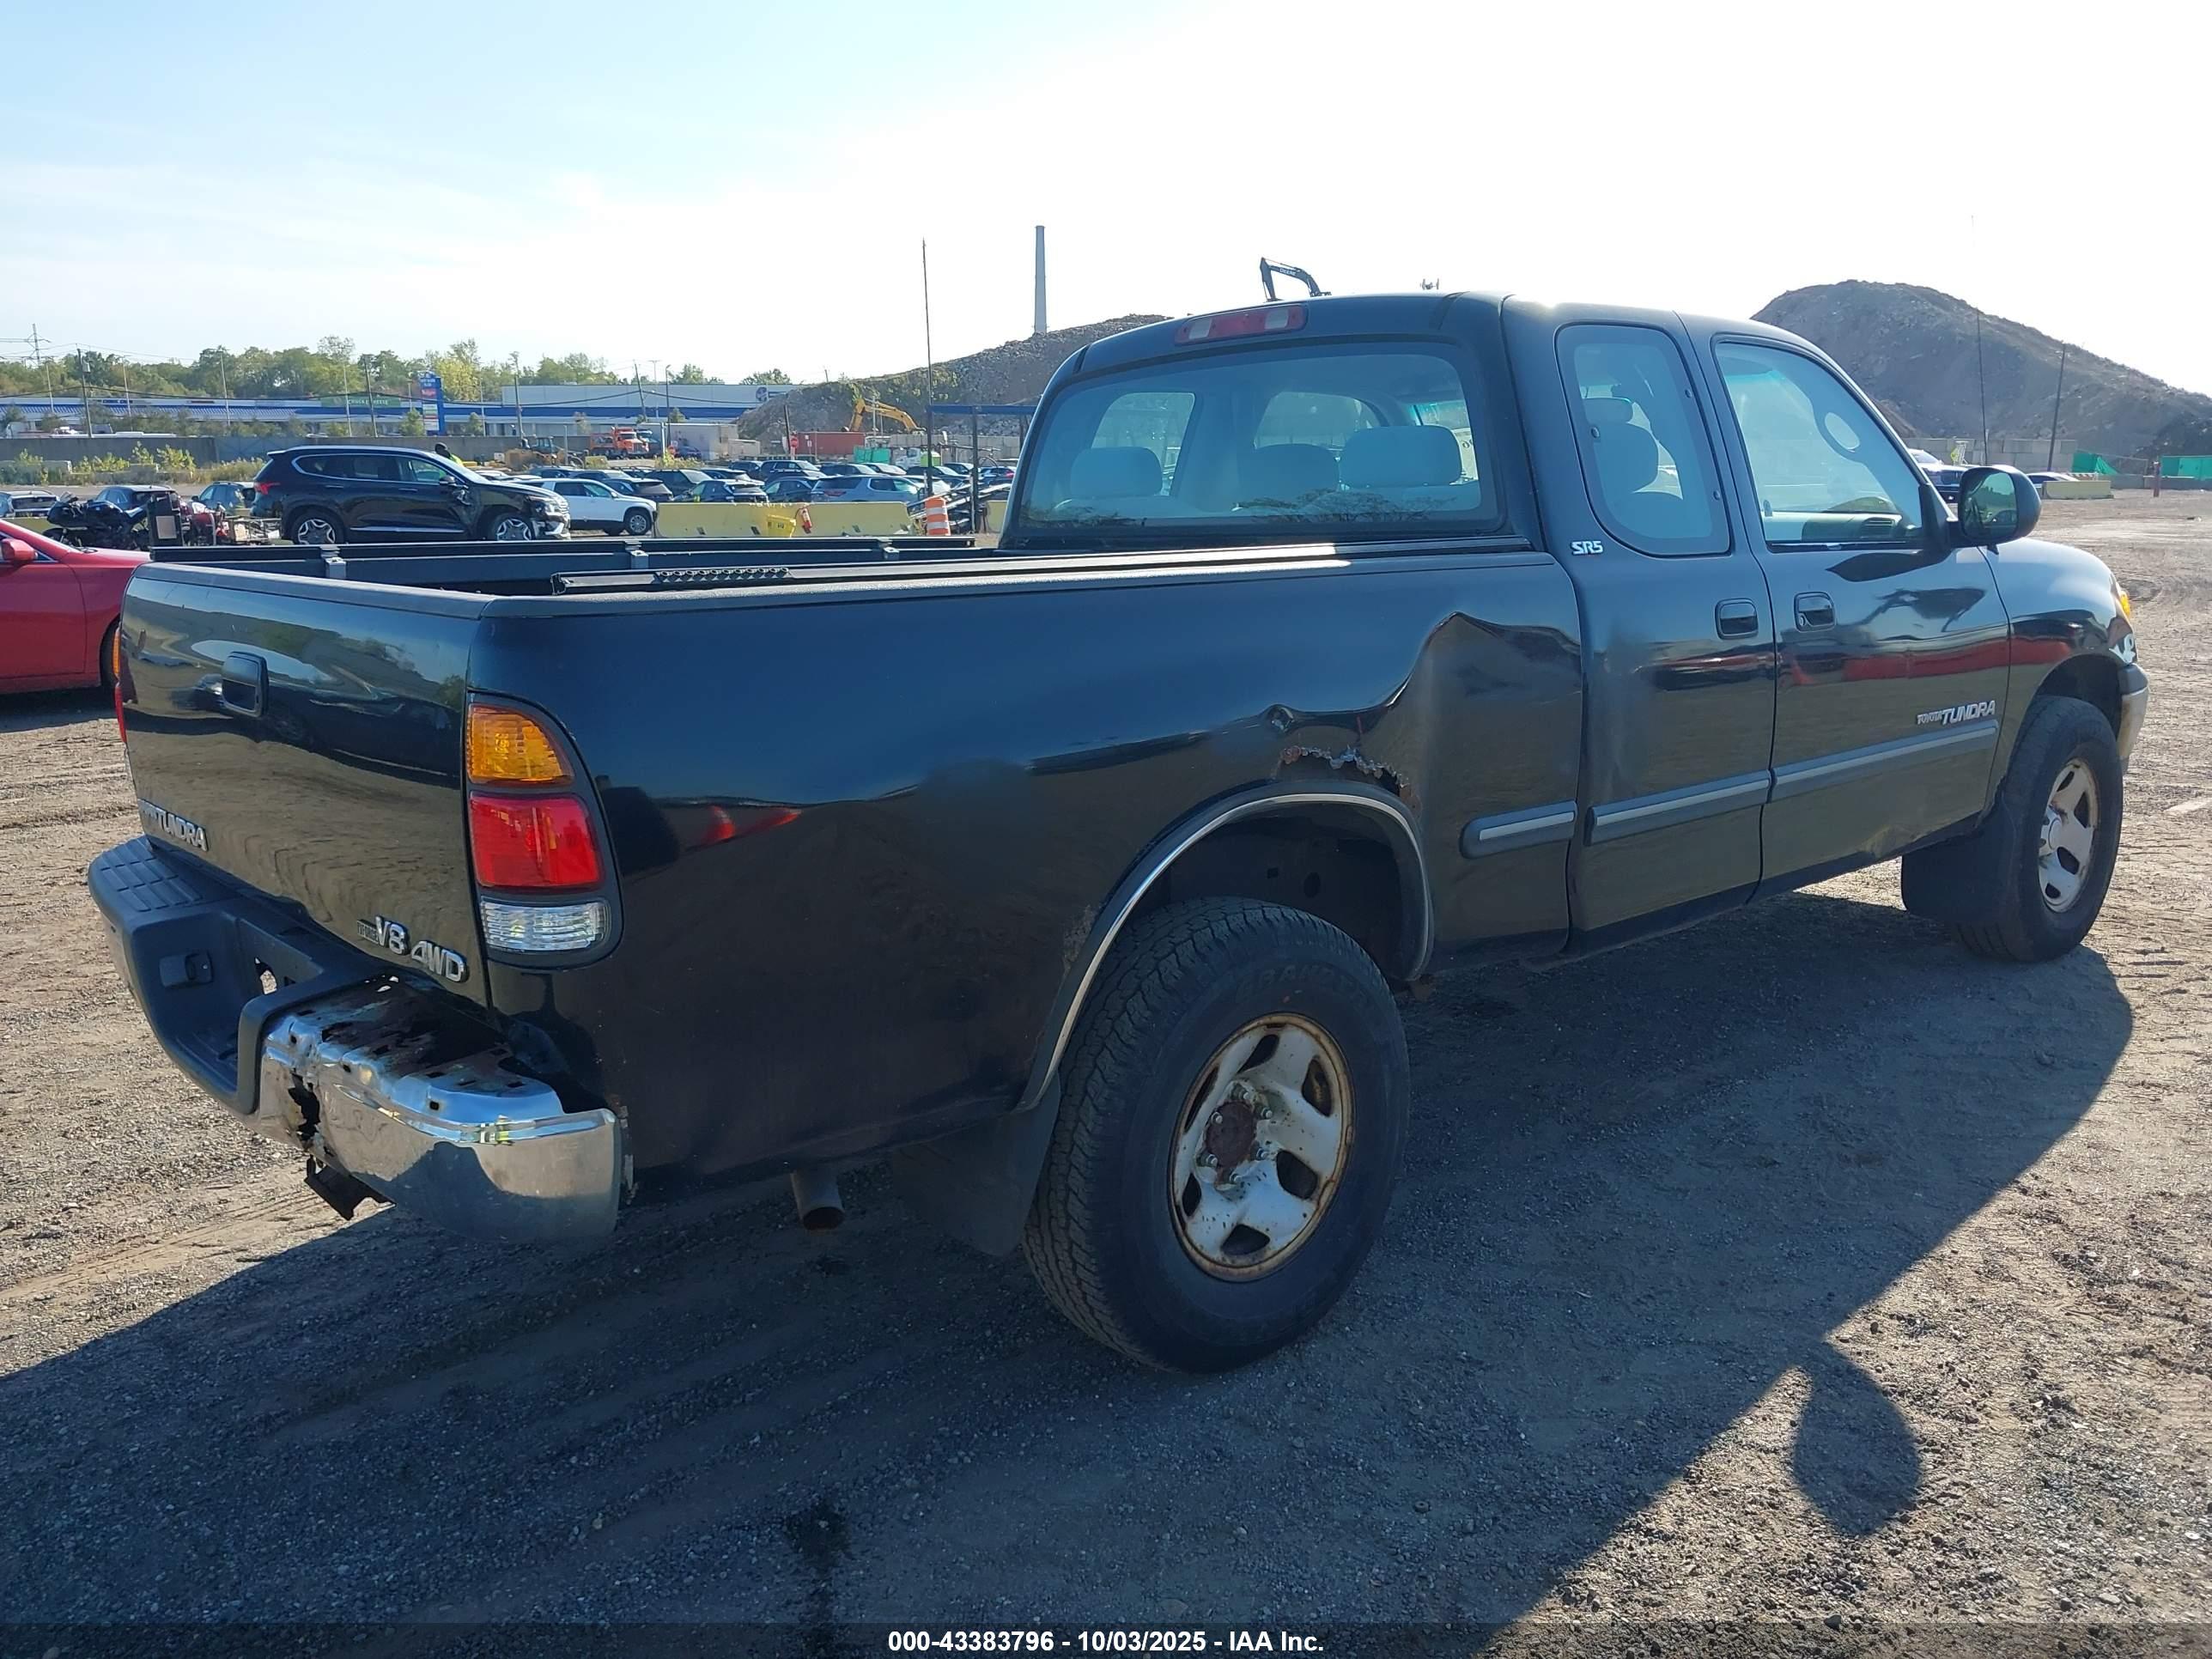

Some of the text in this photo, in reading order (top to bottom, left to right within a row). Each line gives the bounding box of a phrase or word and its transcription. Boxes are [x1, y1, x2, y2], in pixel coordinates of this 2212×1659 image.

[1571, 540, 1604, 555] SR5
[1942, 700, 1996, 725] TUNDRA
[156, 807, 208, 852] TUNDRA
[375, 915, 407, 955] V8
[411, 940, 465, 982] 4WD
